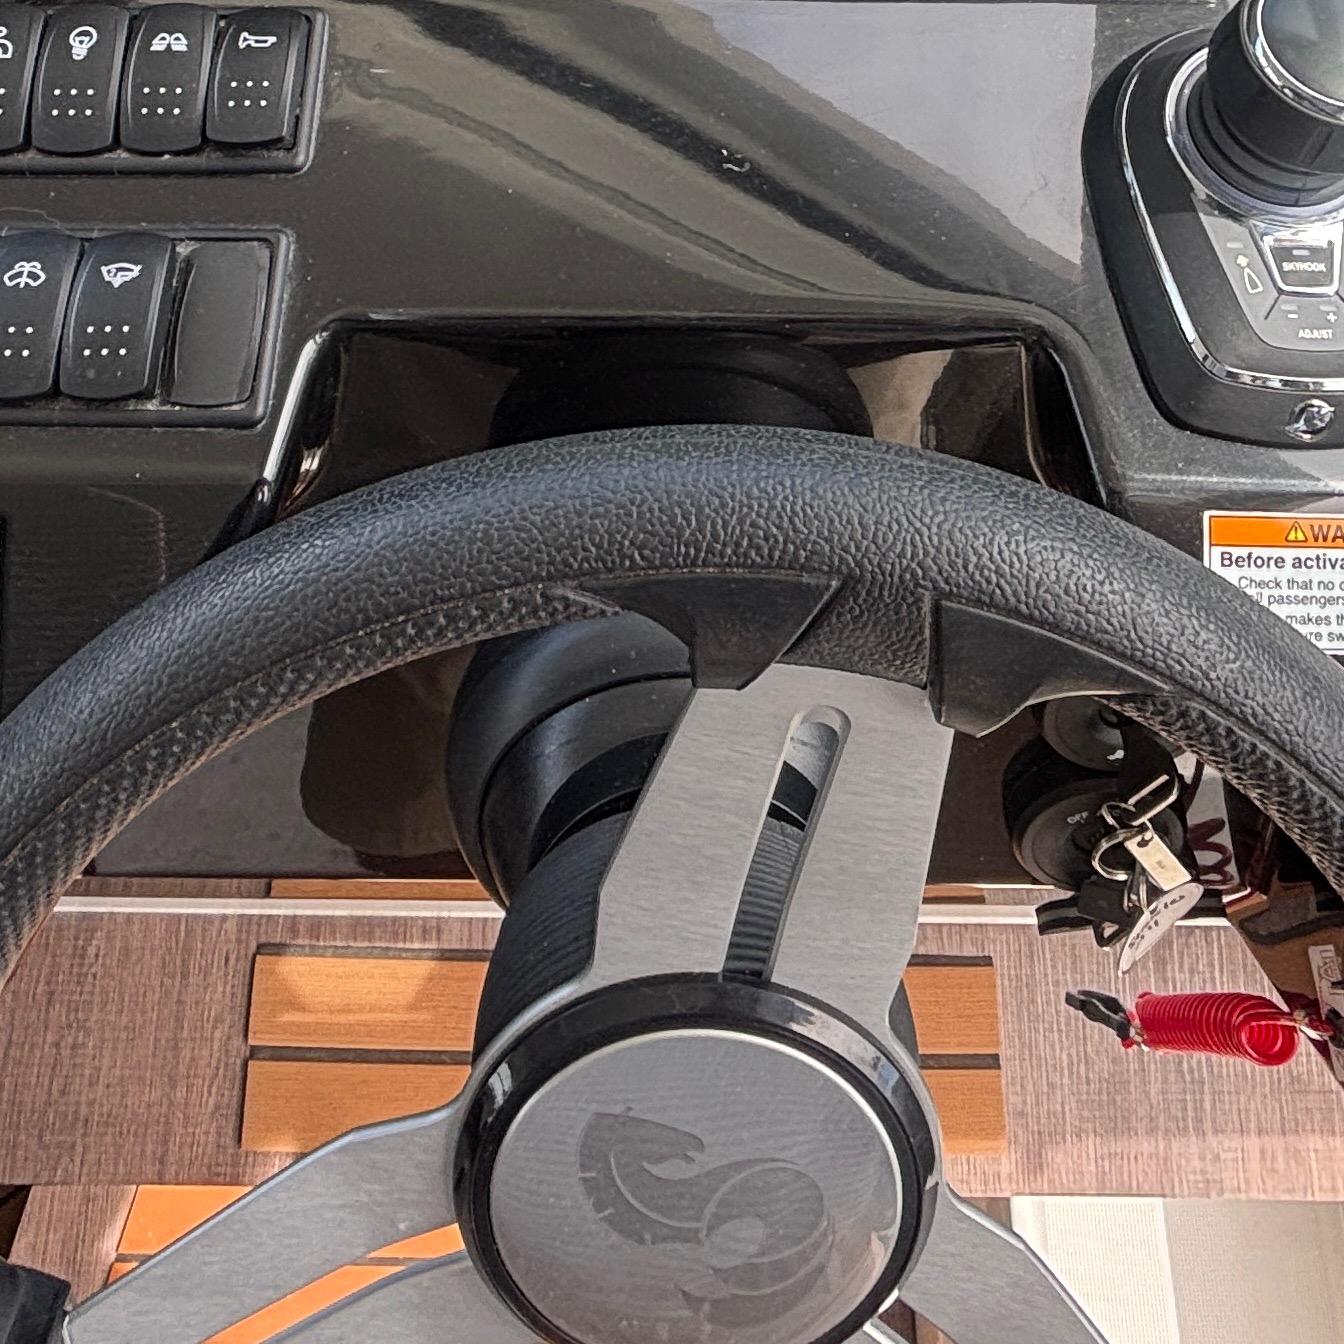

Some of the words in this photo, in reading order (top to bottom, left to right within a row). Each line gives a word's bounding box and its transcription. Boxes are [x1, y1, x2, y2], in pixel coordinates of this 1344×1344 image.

[1281, 261, 1327, 273] SKYHOOK
[1298, 328, 1333, 339] ADJUST
[1220, 551, 1286, 570] Before
[1238, 576, 1282, 591] Check
[1287, 578, 1313, 592] that
[1317, 580, 1335, 592] no
